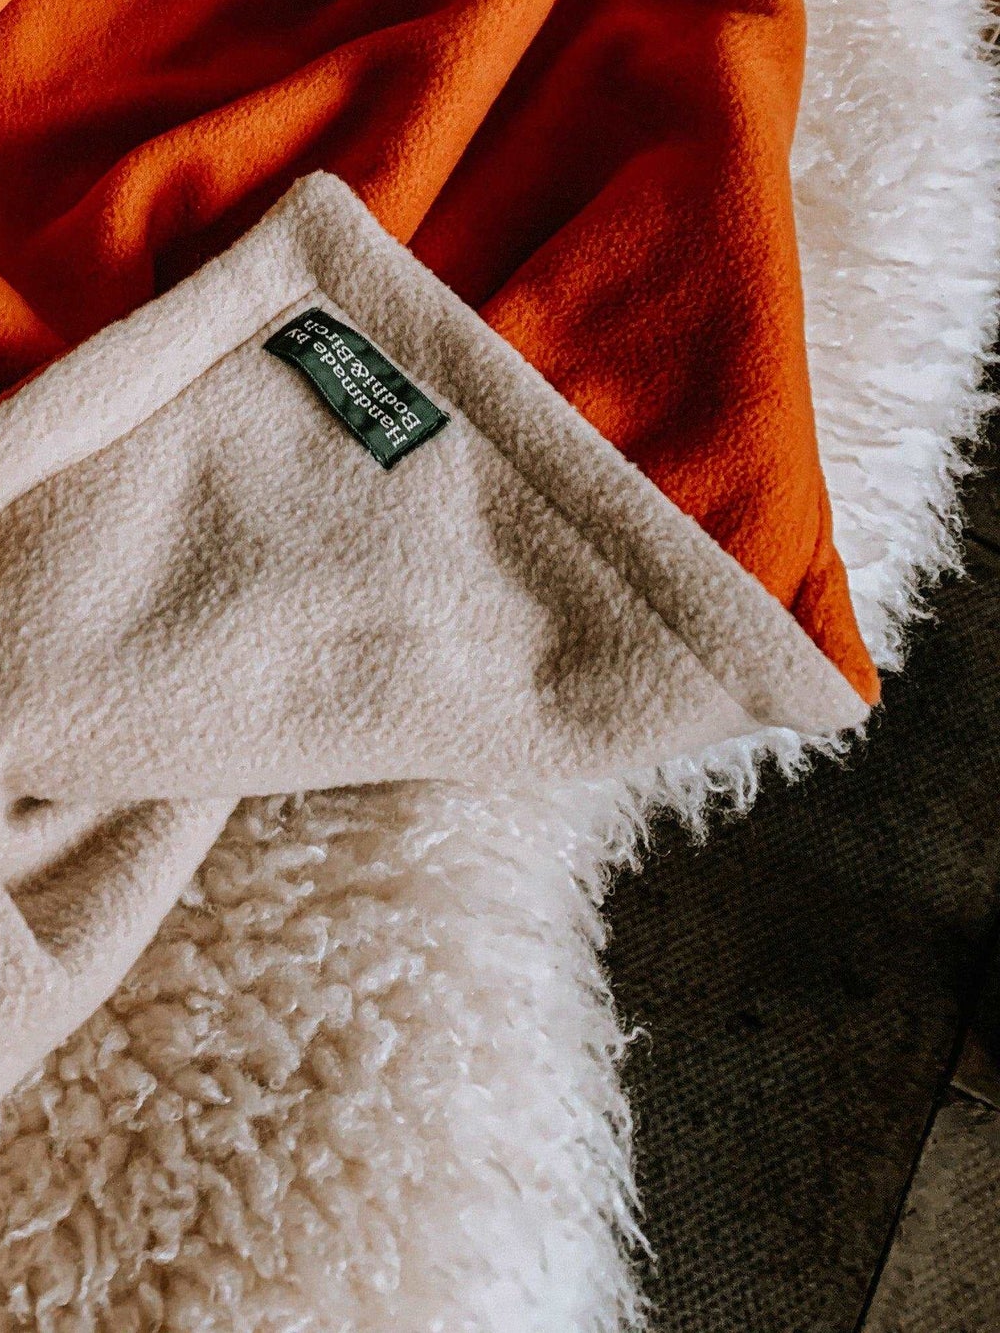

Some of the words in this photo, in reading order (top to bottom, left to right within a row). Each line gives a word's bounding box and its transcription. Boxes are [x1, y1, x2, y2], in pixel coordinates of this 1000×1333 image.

[284, 328, 312, 346] by
[303, 319, 422, 433] Bodhi&Birch
[312, 340, 408, 449] Handmade
